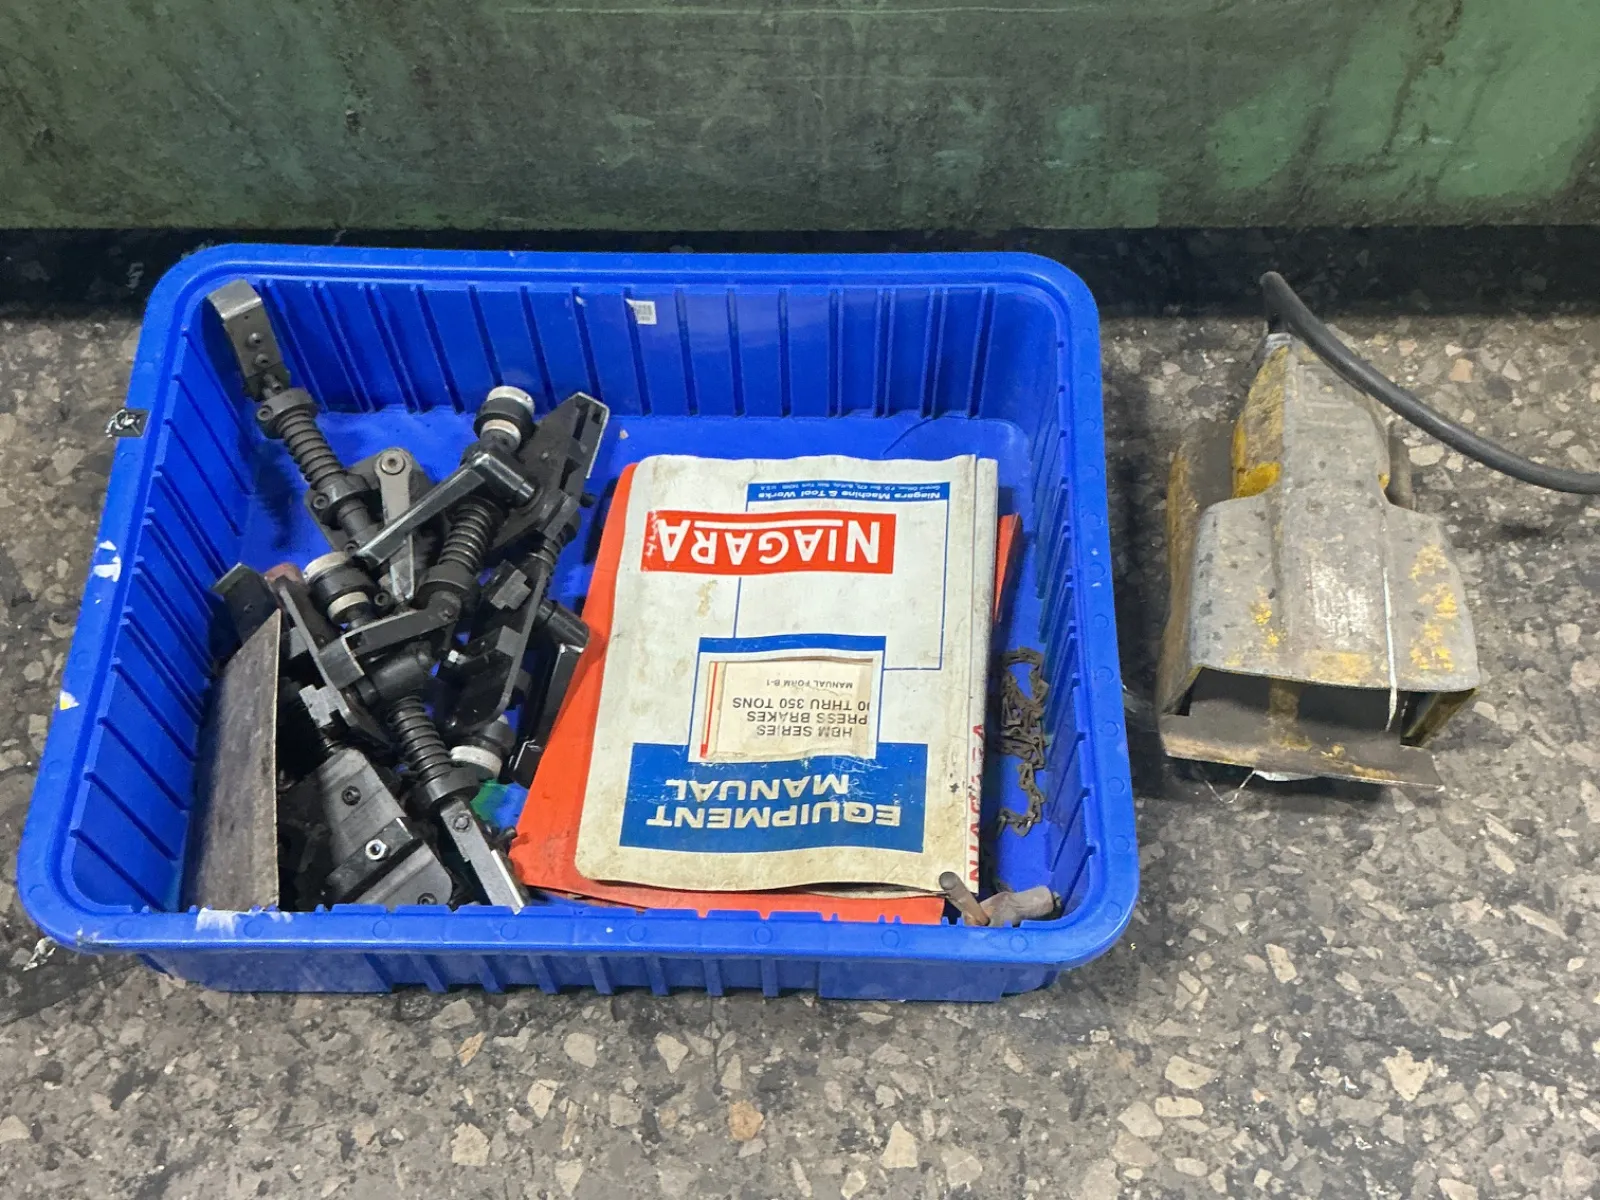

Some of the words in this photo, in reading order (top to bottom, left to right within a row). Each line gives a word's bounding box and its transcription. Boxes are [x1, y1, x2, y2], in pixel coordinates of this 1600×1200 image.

[758, 491, 797, 499] Works
[841, 490, 891, 499] Machine
[894, 491, 941, 500] Niagara
[658, 519, 881, 566] NIAGARA
[784, 679, 810, 687] FORM
[813, 680, 853, 689] MANUAL
[732, 697, 774, 709] TONS
[779, 698, 804, 709] 350
[810, 699, 851, 711] THRU
[747, 711, 810, 723] BRAKES
[816, 712, 868, 725] PRESS
[756, 725, 813, 737] SERIES
[818, 726, 852, 738] HBM
[665, 774, 849, 802] MANUAL
[646, 801, 902, 829] EQUIPMENT
